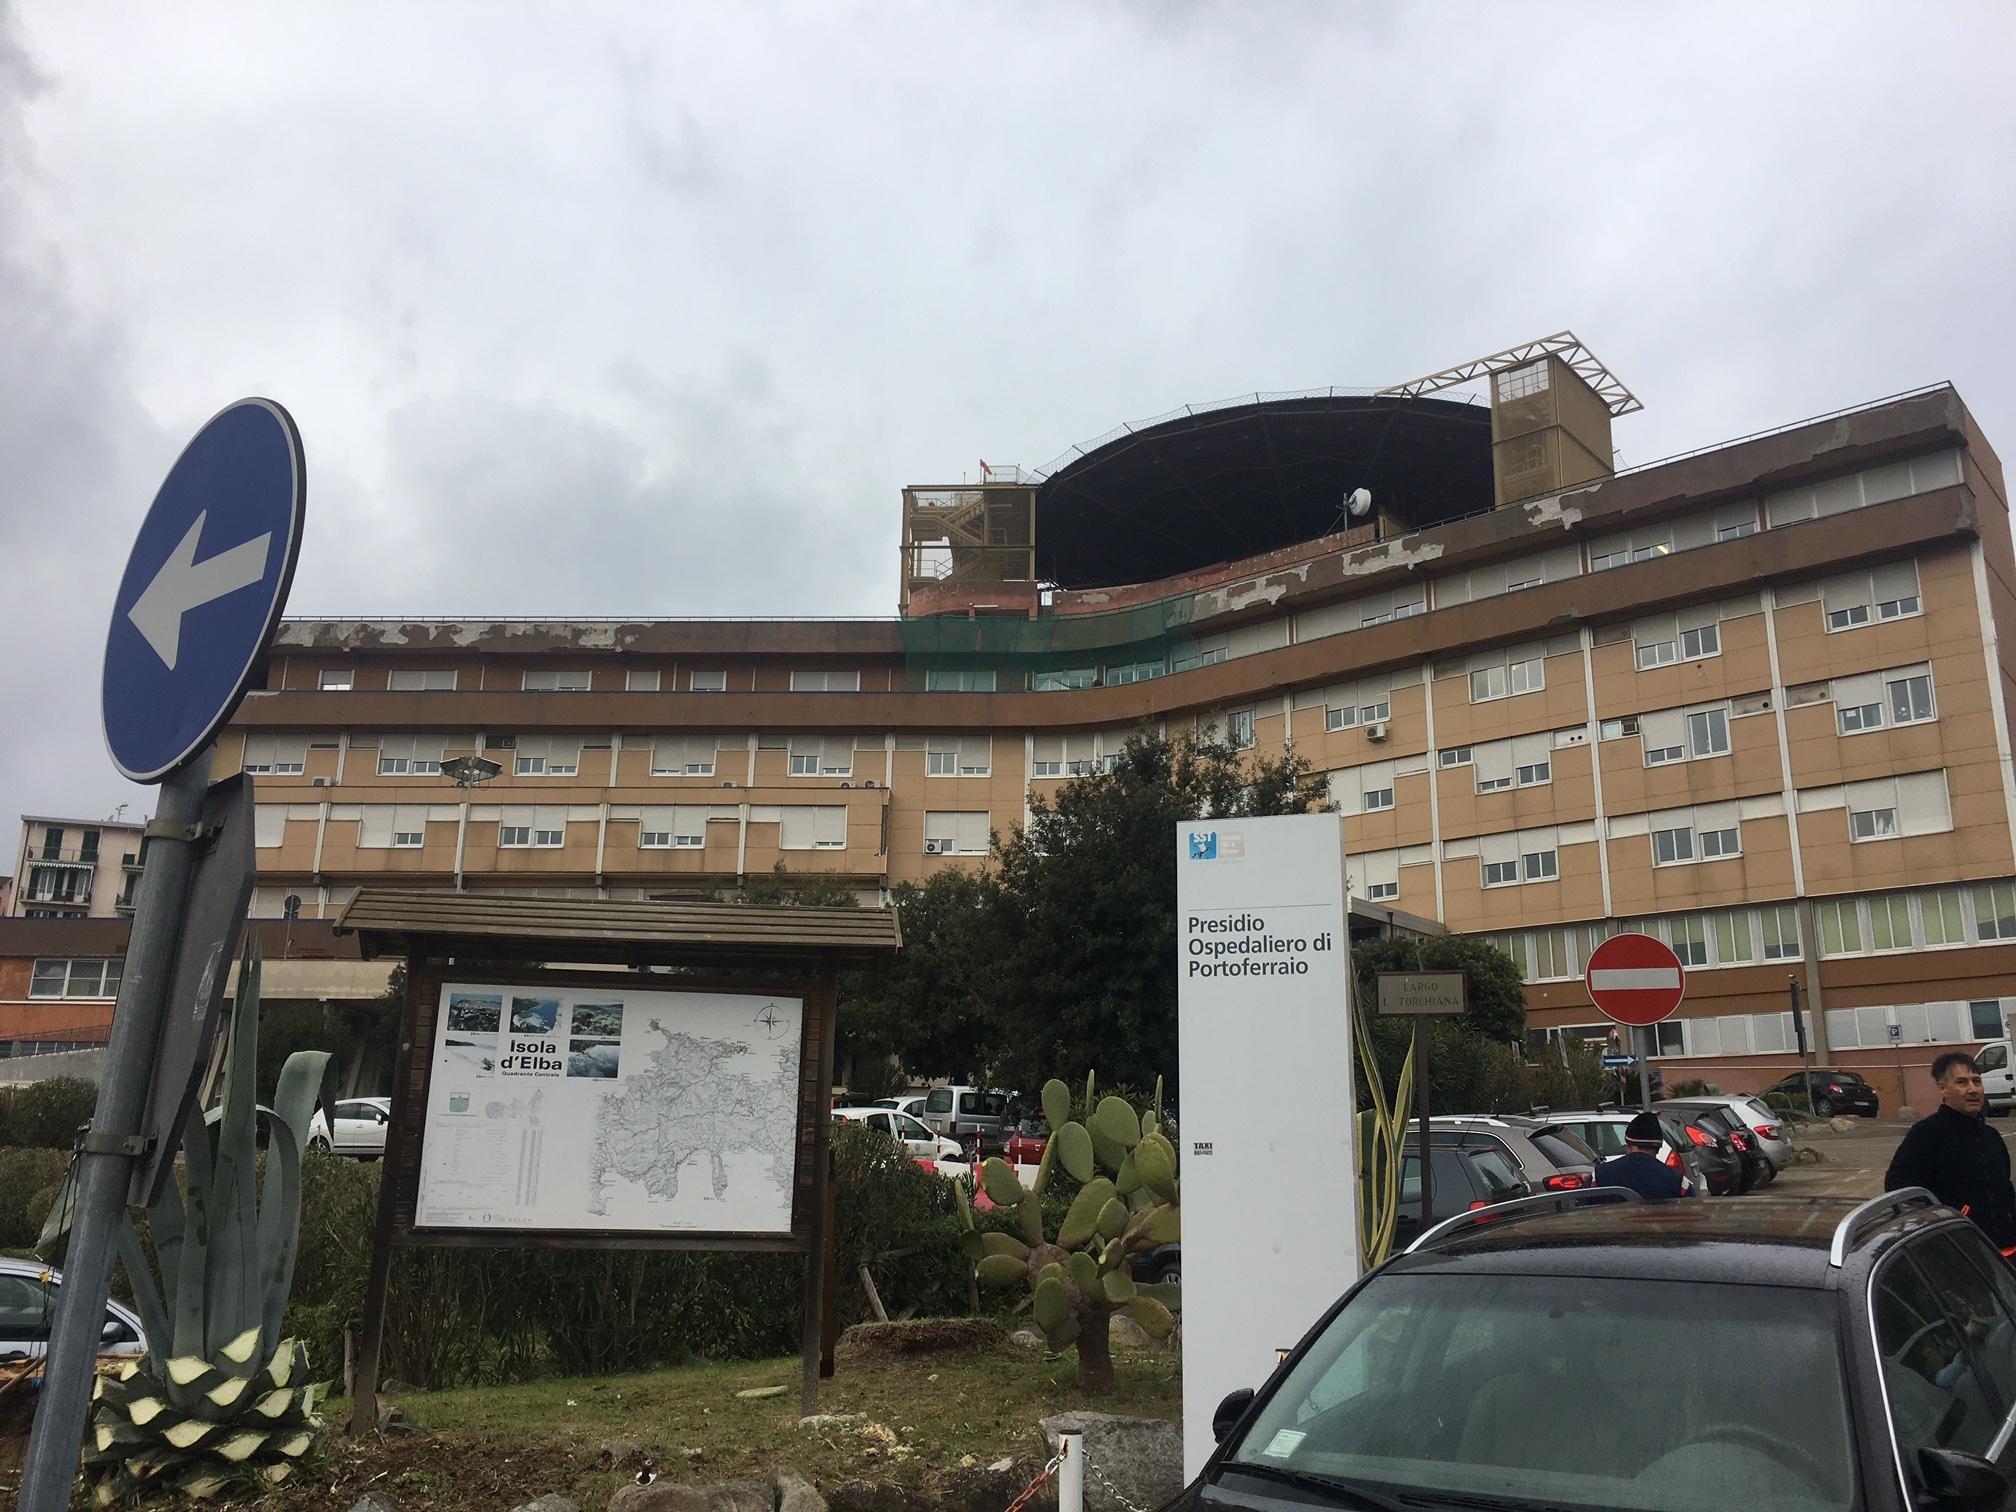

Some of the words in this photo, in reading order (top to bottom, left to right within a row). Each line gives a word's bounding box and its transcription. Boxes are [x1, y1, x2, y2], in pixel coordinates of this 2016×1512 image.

[1188, 914, 1265, 934] Presidio
[1188, 935, 1307, 959] Ospedaliero
[1312, 933, 1332, 952] di
[1189, 957, 1309, 978] Portoferraio
[1403, 982, 1438, 992] LARGO
[1399, 996, 1459, 1007] TORCHIANA
[510, 1039, 557, 1054] Isola
[500, 1055, 563, 1071] d'Elba
